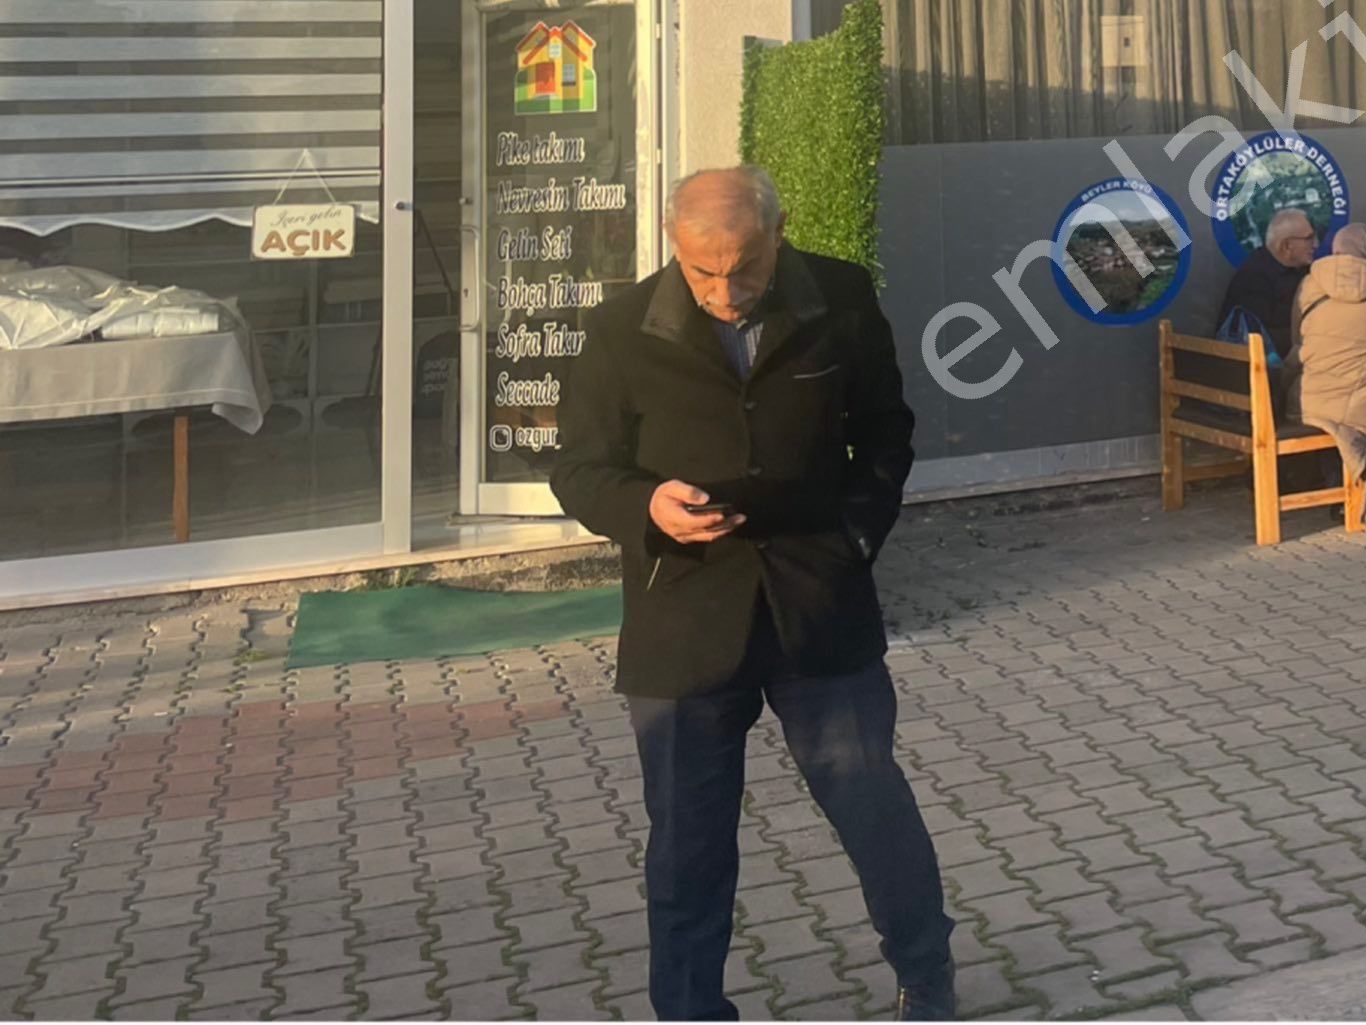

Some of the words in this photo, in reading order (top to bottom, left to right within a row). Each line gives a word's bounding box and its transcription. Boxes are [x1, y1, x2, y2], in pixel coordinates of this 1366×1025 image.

[496, 131, 531, 166] Pike
[497, 178, 570, 214] Nevresim
[571, 176, 627, 212] Takımı
[1081, 180, 1121, 203] BEYLER
[1216, 136, 1306, 221] ORTAKÖYLÜLER
[1306, 146, 1347, 216] DERNEĞİ
[260, 227, 347, 257] AÇIK
[498, 227, 539, 262] Gelin
[540, 225, 573, 261] Seti
[498, 276, 547, 317] Bohça
[495, 322, 542, 363] Sofra
[495, 371, 561, 407] Seccade
